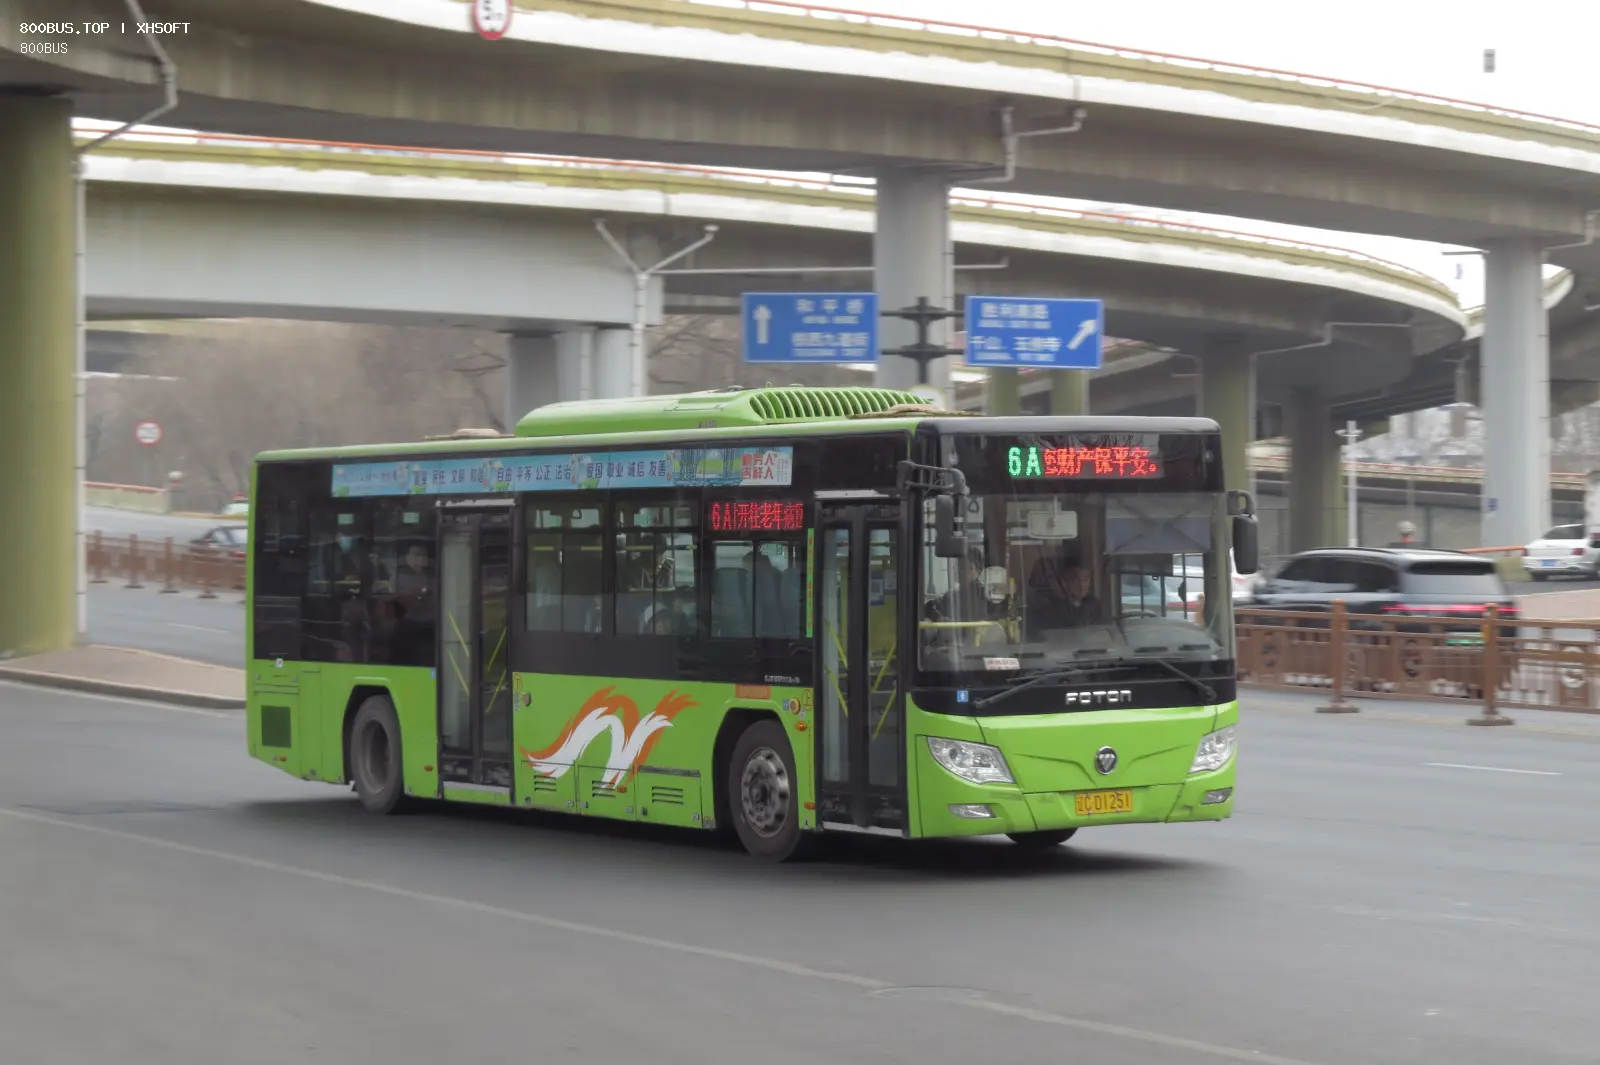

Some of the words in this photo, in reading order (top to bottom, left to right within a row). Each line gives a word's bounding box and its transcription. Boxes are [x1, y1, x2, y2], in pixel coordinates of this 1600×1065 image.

[516, 466, 532, 481] 平等
[536, 464, 551, 480] 公正
[555, 464, 571, 480] 法治
[586, 462, 603, 479] 爱国
[607, 461, 624, 478] 敬业
[628, 461, 645, 477] 诚信
[649, 460, 667, 477] 友善
[1008, 446, 1042, 476] 6A
[1065, 689, 1132, 705] FOTON
